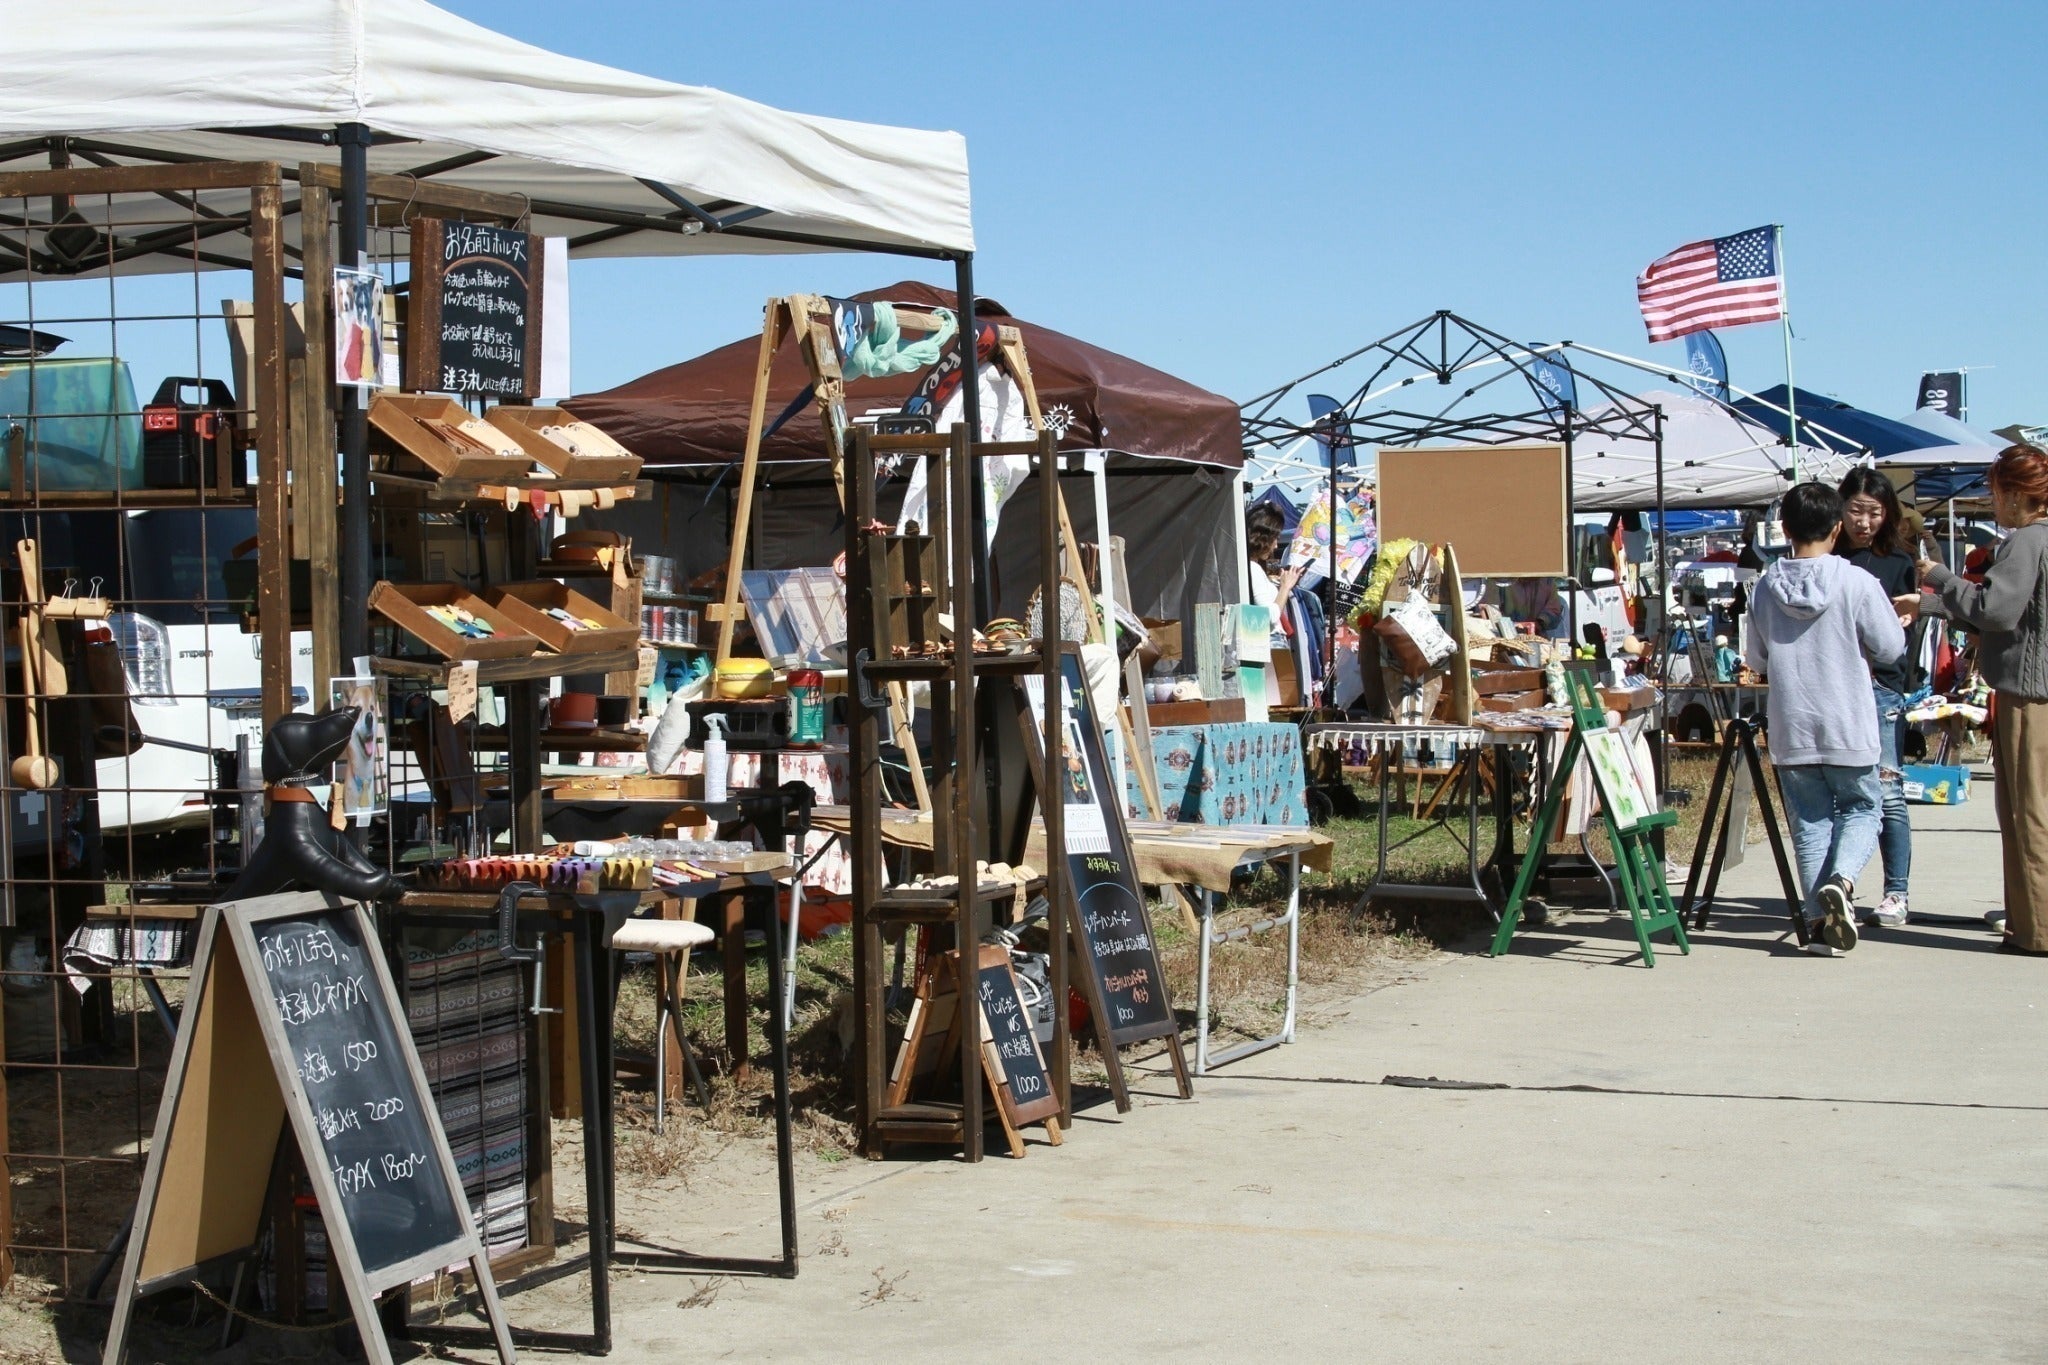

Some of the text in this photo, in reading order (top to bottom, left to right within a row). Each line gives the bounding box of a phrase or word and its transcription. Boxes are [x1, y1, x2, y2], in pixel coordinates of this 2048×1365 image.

[343, 1040, 378, 1072] 1500
[1015, 1075, 1040, 1095] 1000
[364, 1097, 404, 1121] 2000
